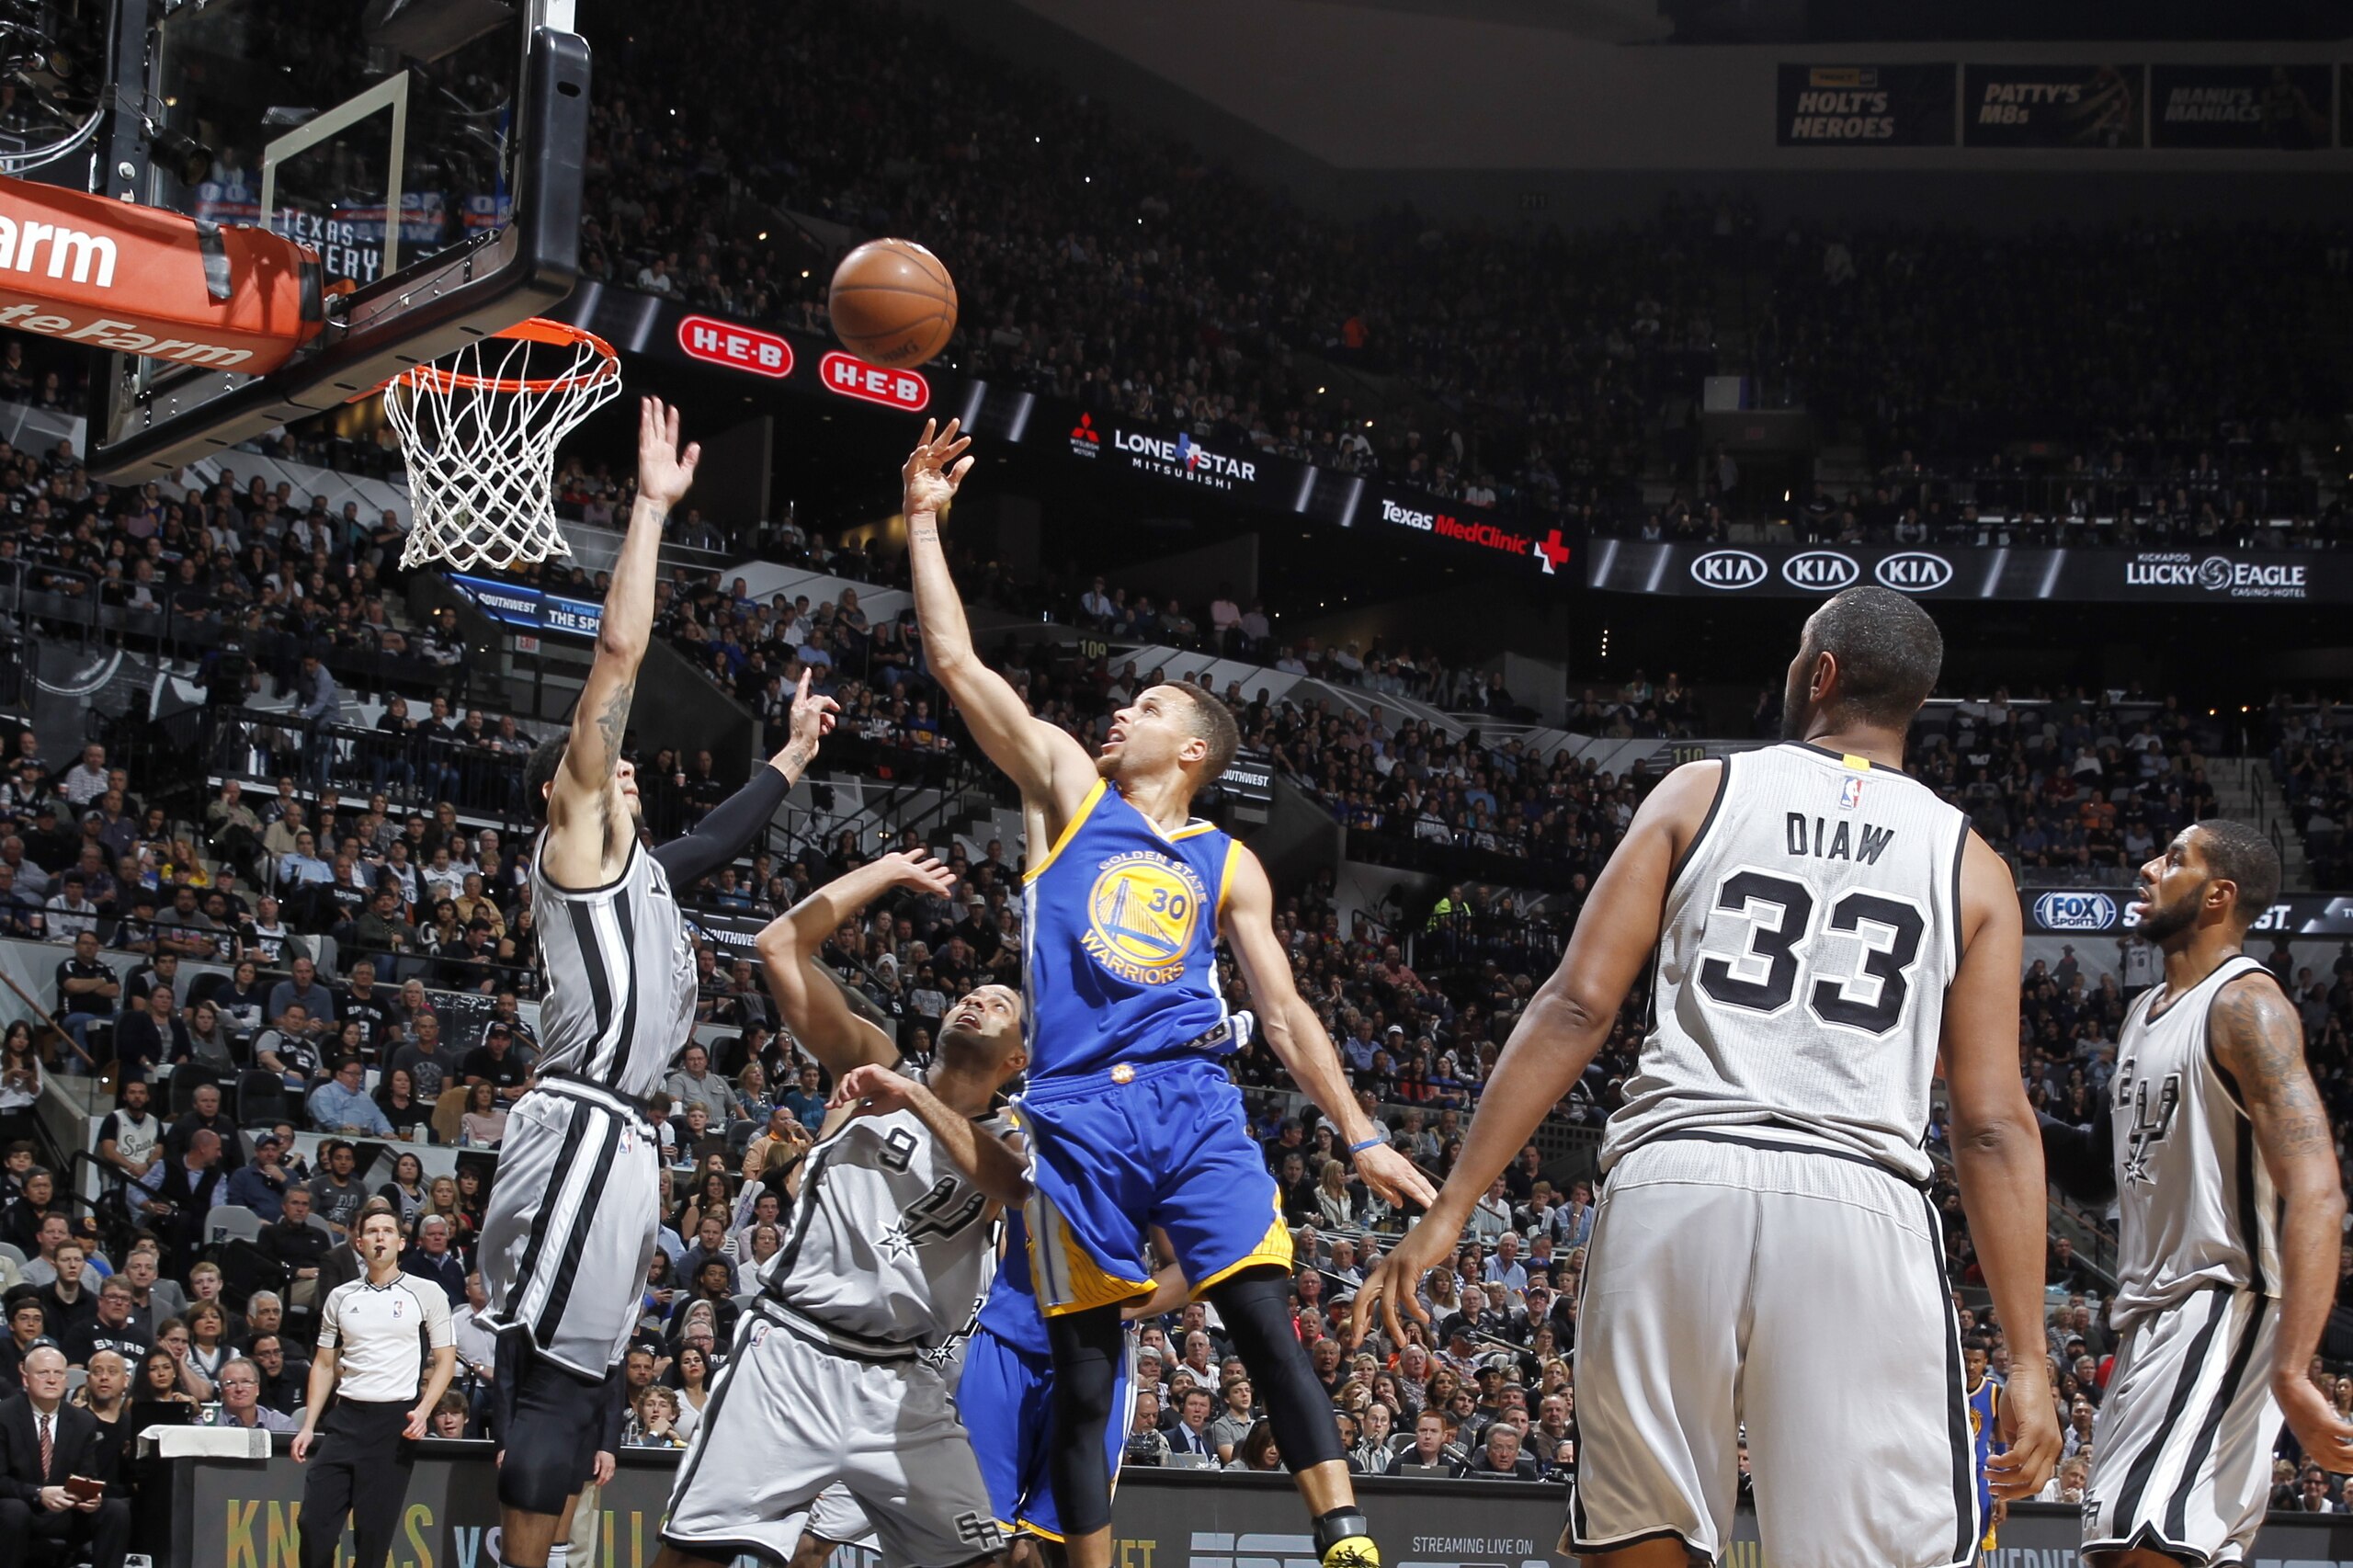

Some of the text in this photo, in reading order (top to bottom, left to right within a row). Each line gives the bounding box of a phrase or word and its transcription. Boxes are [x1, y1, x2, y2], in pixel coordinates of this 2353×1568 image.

[1798, 92, 1888, 113] HOLT'S
[1984, 84, 2081, 104] PATTY'S
[2165, 105, 2262, 121] MANIACS
[1791, 117, 1894, 139] HEROES
[283, 207, 354, 246] TEXAS
[62, 319, 254, 366] Farm
[1115, 429, 1256, 482] LONE STAR
[1132, 458, 1232, 490] MITSUBISHI
[1382, 499, 1528, 555] Texas MedClinic
[1704, 559, 1755, 581] KIA
[1796, 559, 1847, 582] KIA
[1888, 560, 1939, 583] KIA
[2127, 562, 2306, 586] LUCKY EAGLE
[549, 609, 575, 627] THE
[1219, 769, 1269, 787] OUTHWEST
[1787, 812, 1894, 866] DIAW
[1097, 851, 1209, 904] GOLDEN STATE
[1147, 888, 1187, 920] 30
[2052, 897, 2097, 919] FOX
[2052, 918, 2097, 927] SPORTS
[1080, 928, 1185, 985] WARRIORS
[1692, 864, 1933, 1041] 33
[876, 1124, 918, 1176] 9
[1412, 1537, 1533, 1555] STREAMING LIVE ON
